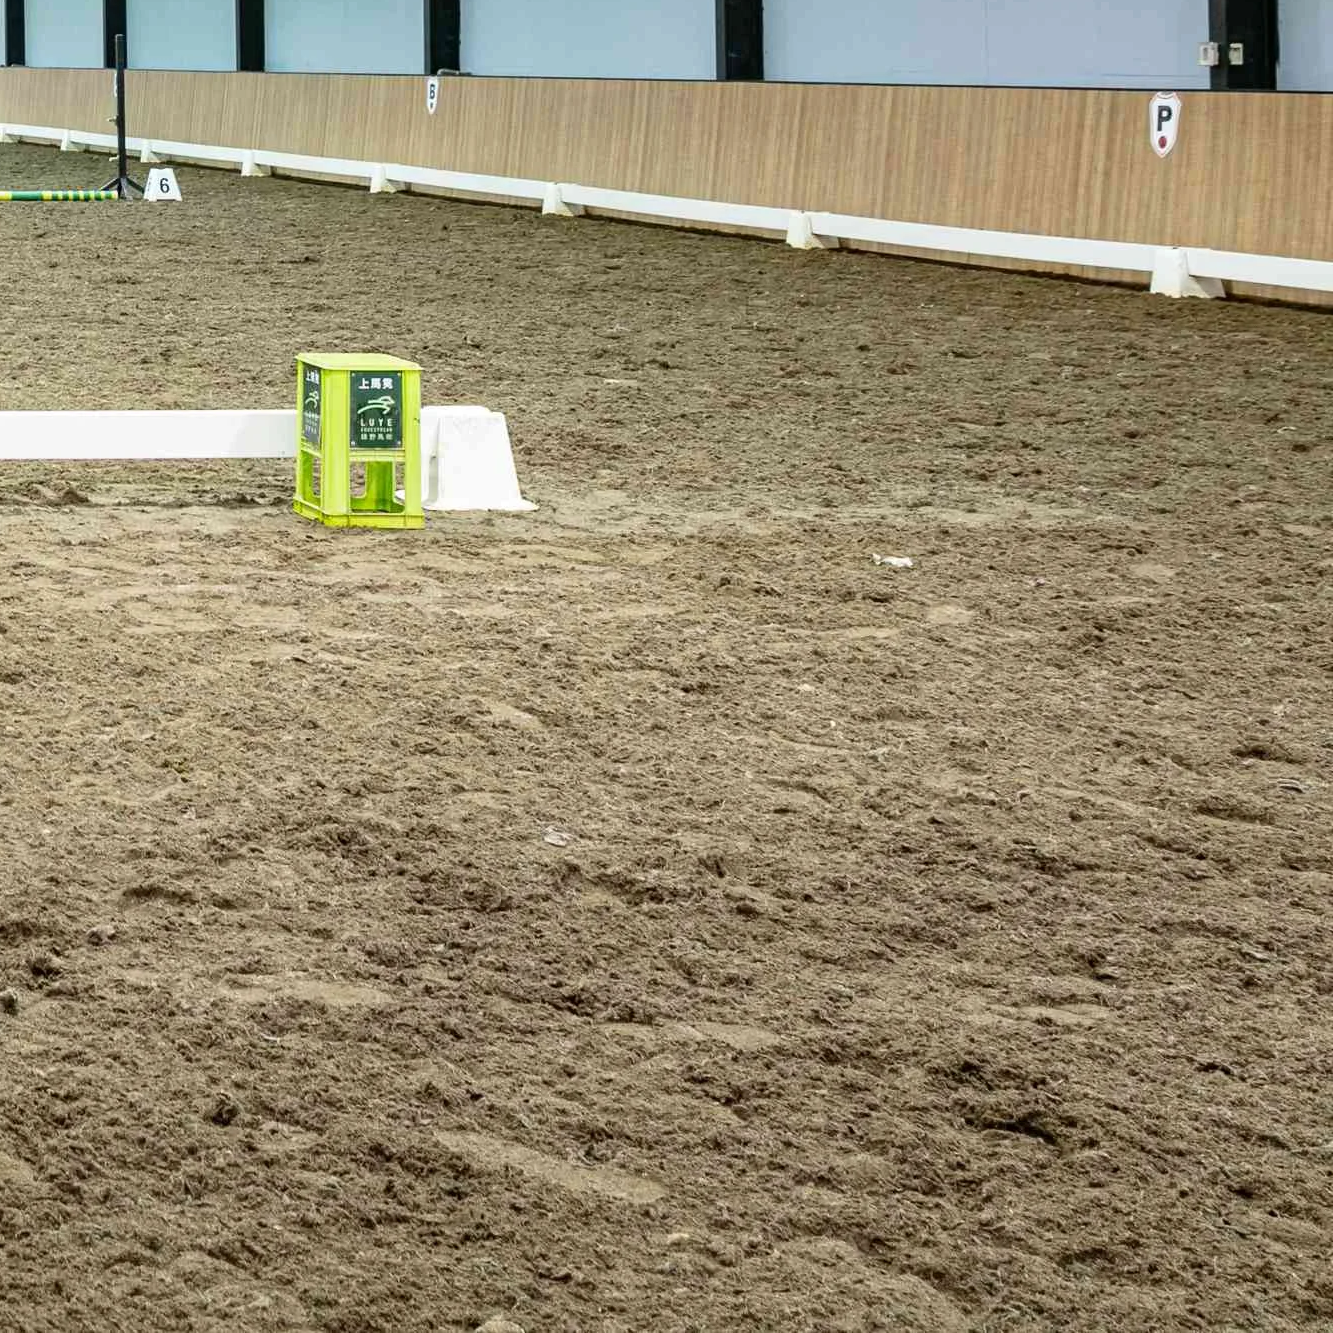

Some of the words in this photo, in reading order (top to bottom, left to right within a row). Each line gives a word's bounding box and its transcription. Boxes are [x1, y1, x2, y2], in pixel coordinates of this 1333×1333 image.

[429, 83, 436, 100] B
[1157, 104, 1174, 132] P
[159, 177, 170, 193] 6
[361, 418, 393, 426] LUYE
